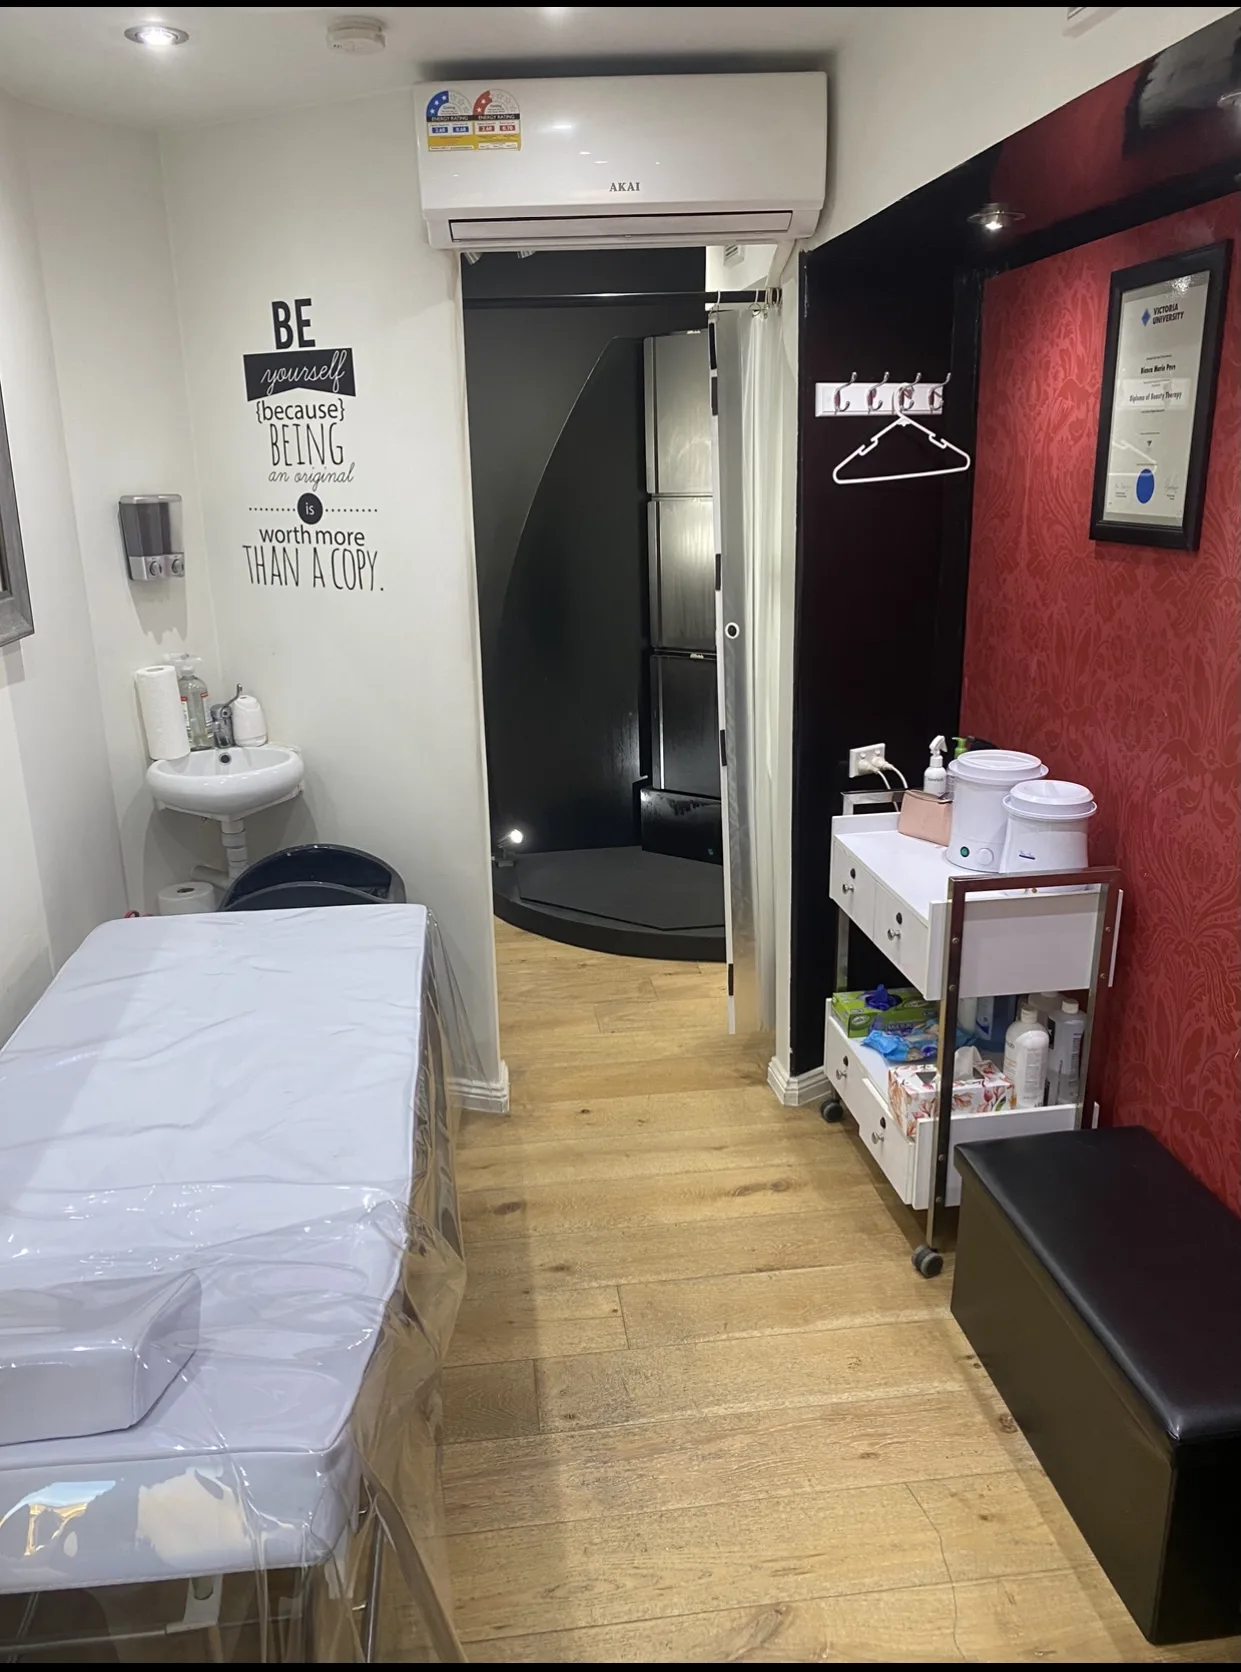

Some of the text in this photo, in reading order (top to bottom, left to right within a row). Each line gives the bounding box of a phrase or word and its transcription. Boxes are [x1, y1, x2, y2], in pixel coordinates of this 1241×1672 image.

[609, 181, 641, 192] AKAI
[1152, 310, 1185, 325] UNIVERSITY
[1153, 302, 1179, 316] VICTORIA
[271, 297, 316, 350] BE
[261, 350, 346, 394] yourself
[1129, 394, 1146, 404] Diploma
[1145, 393, 1150, 401] of
[1165, 391, 1182, 401] Therapy
[255, 397, 346, 425] {because}
[269, 421, 345, 468] BEING
[268, 462, 356, 491] an original
[305, 501, 315, 515] is
[259, 525, 365, 547] worth more
[242, 544, 385, 592] THAN A COPY.
